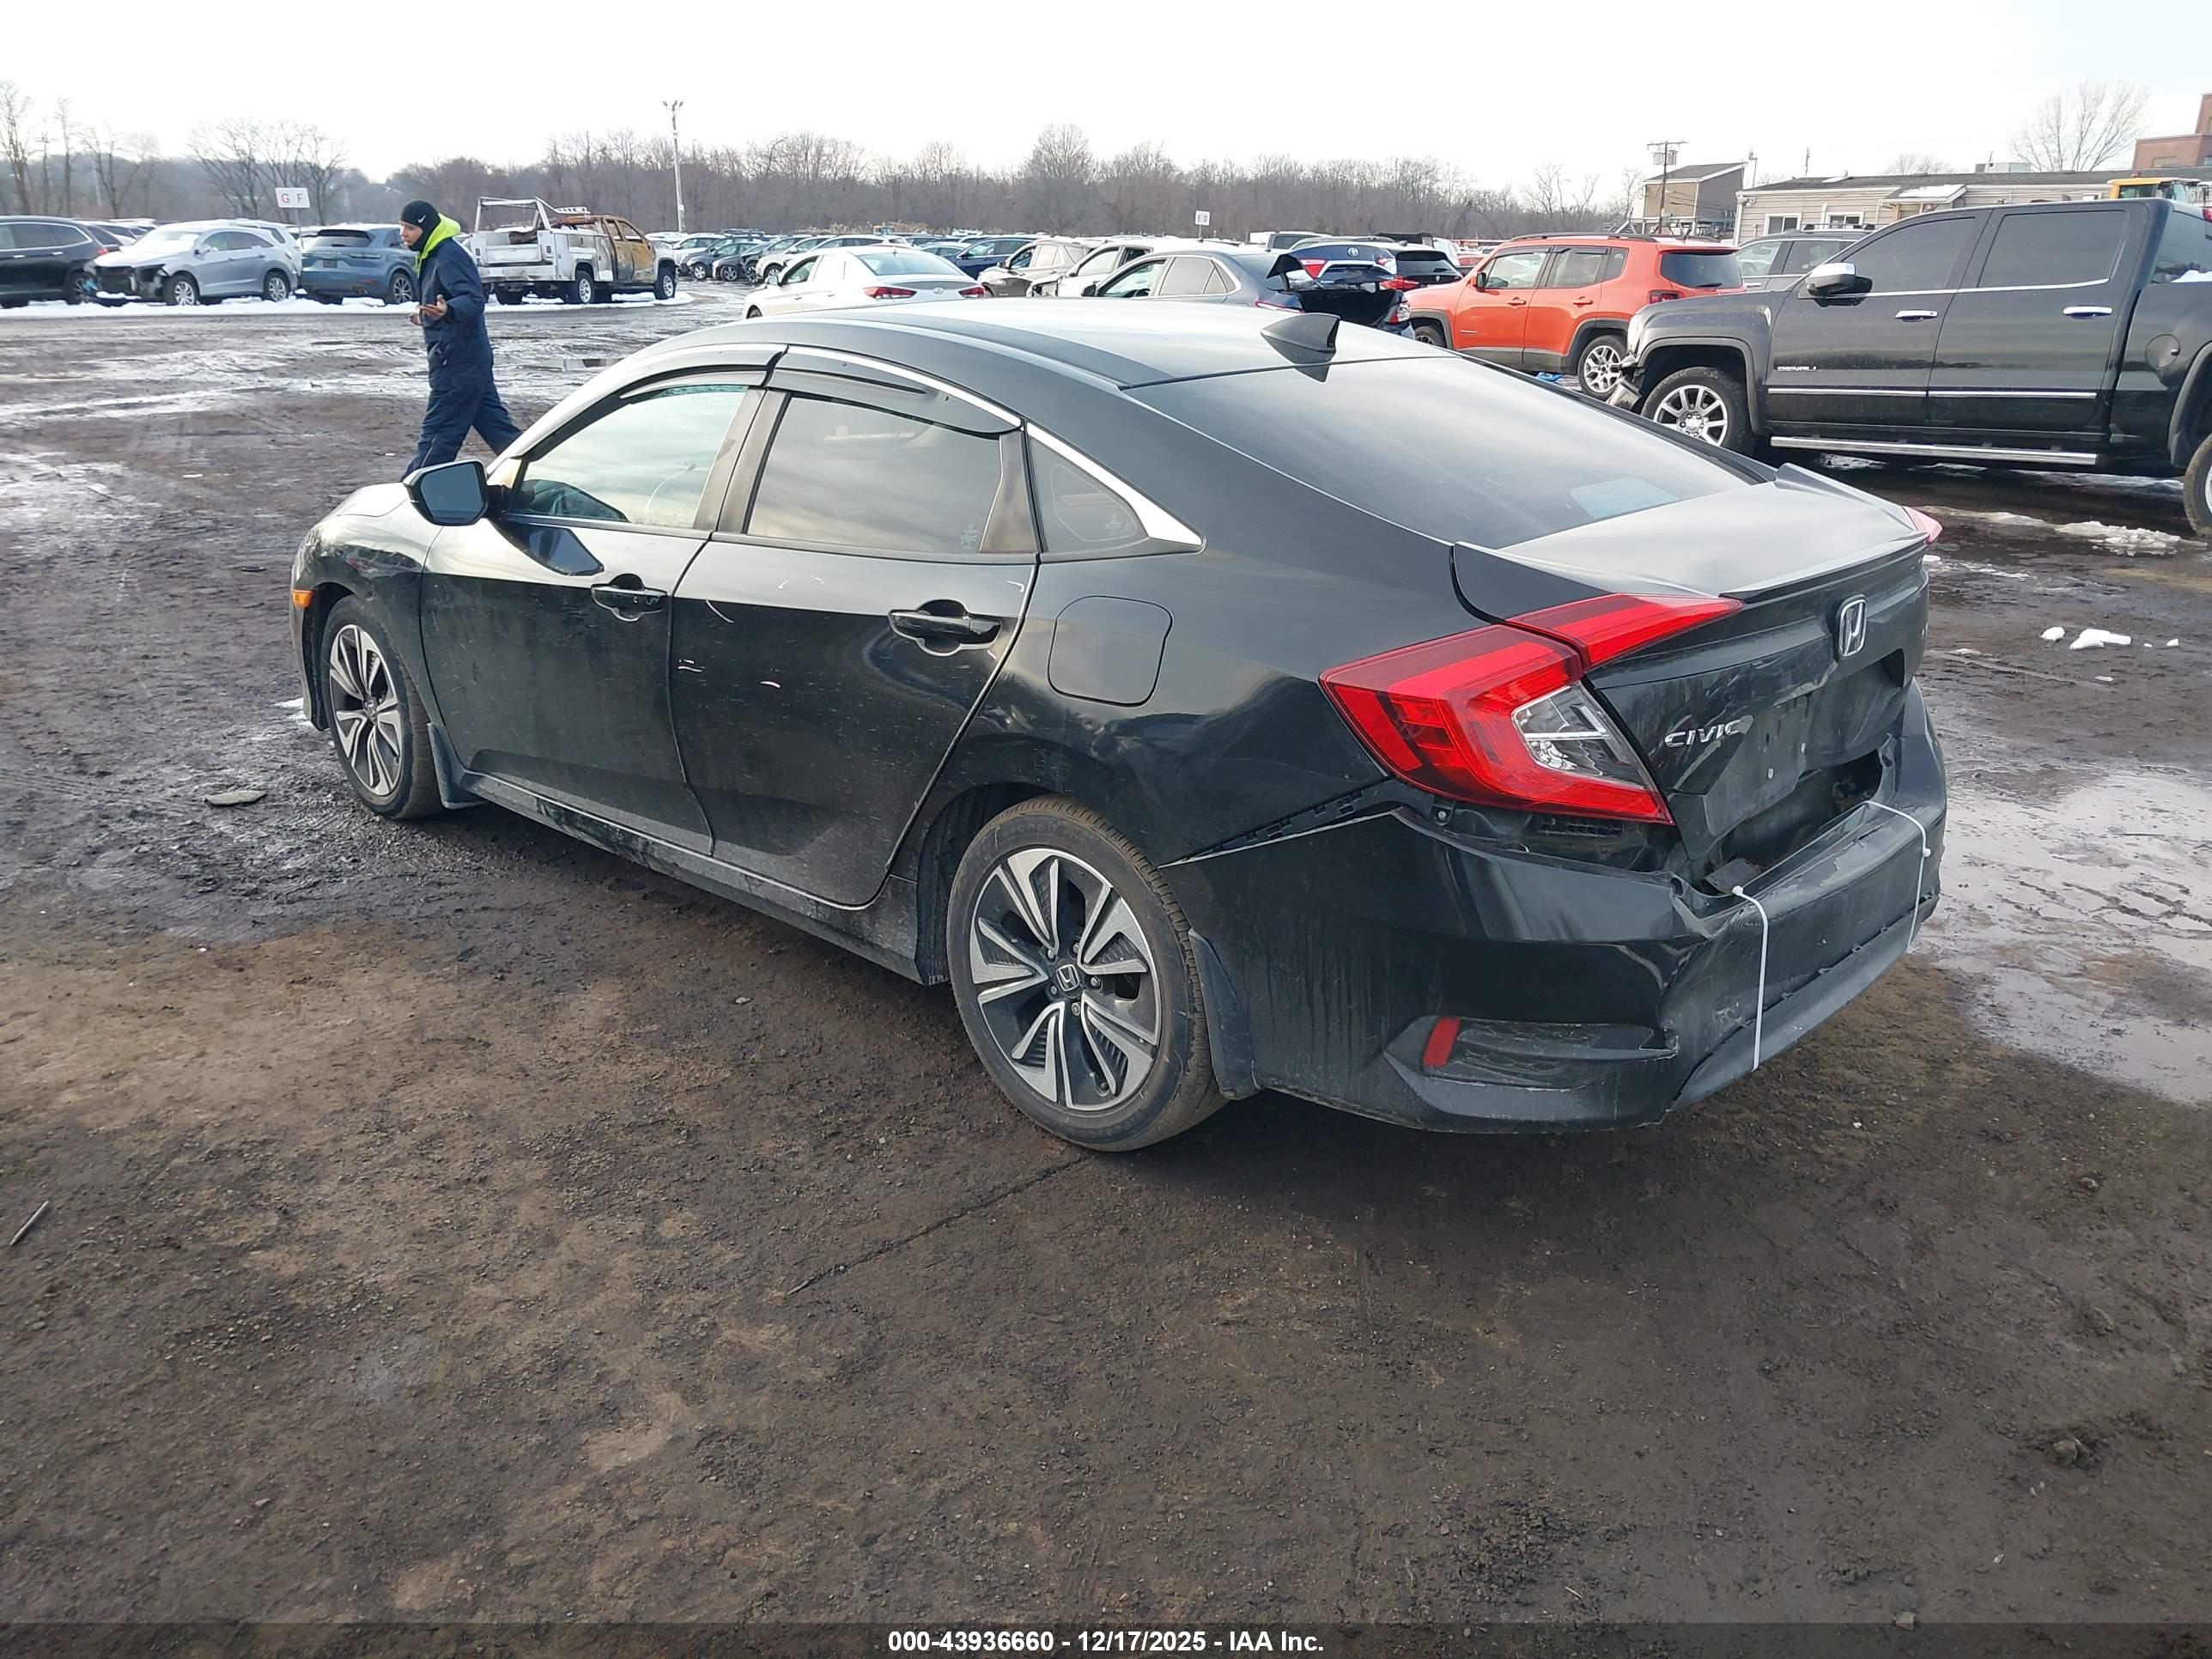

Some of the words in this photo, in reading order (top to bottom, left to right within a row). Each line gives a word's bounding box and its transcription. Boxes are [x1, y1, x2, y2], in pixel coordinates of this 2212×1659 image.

[281, 193, 290, 204] G
[296, 193, 303, 204] F
[1664, 720, 1741, 748] CIVIC
